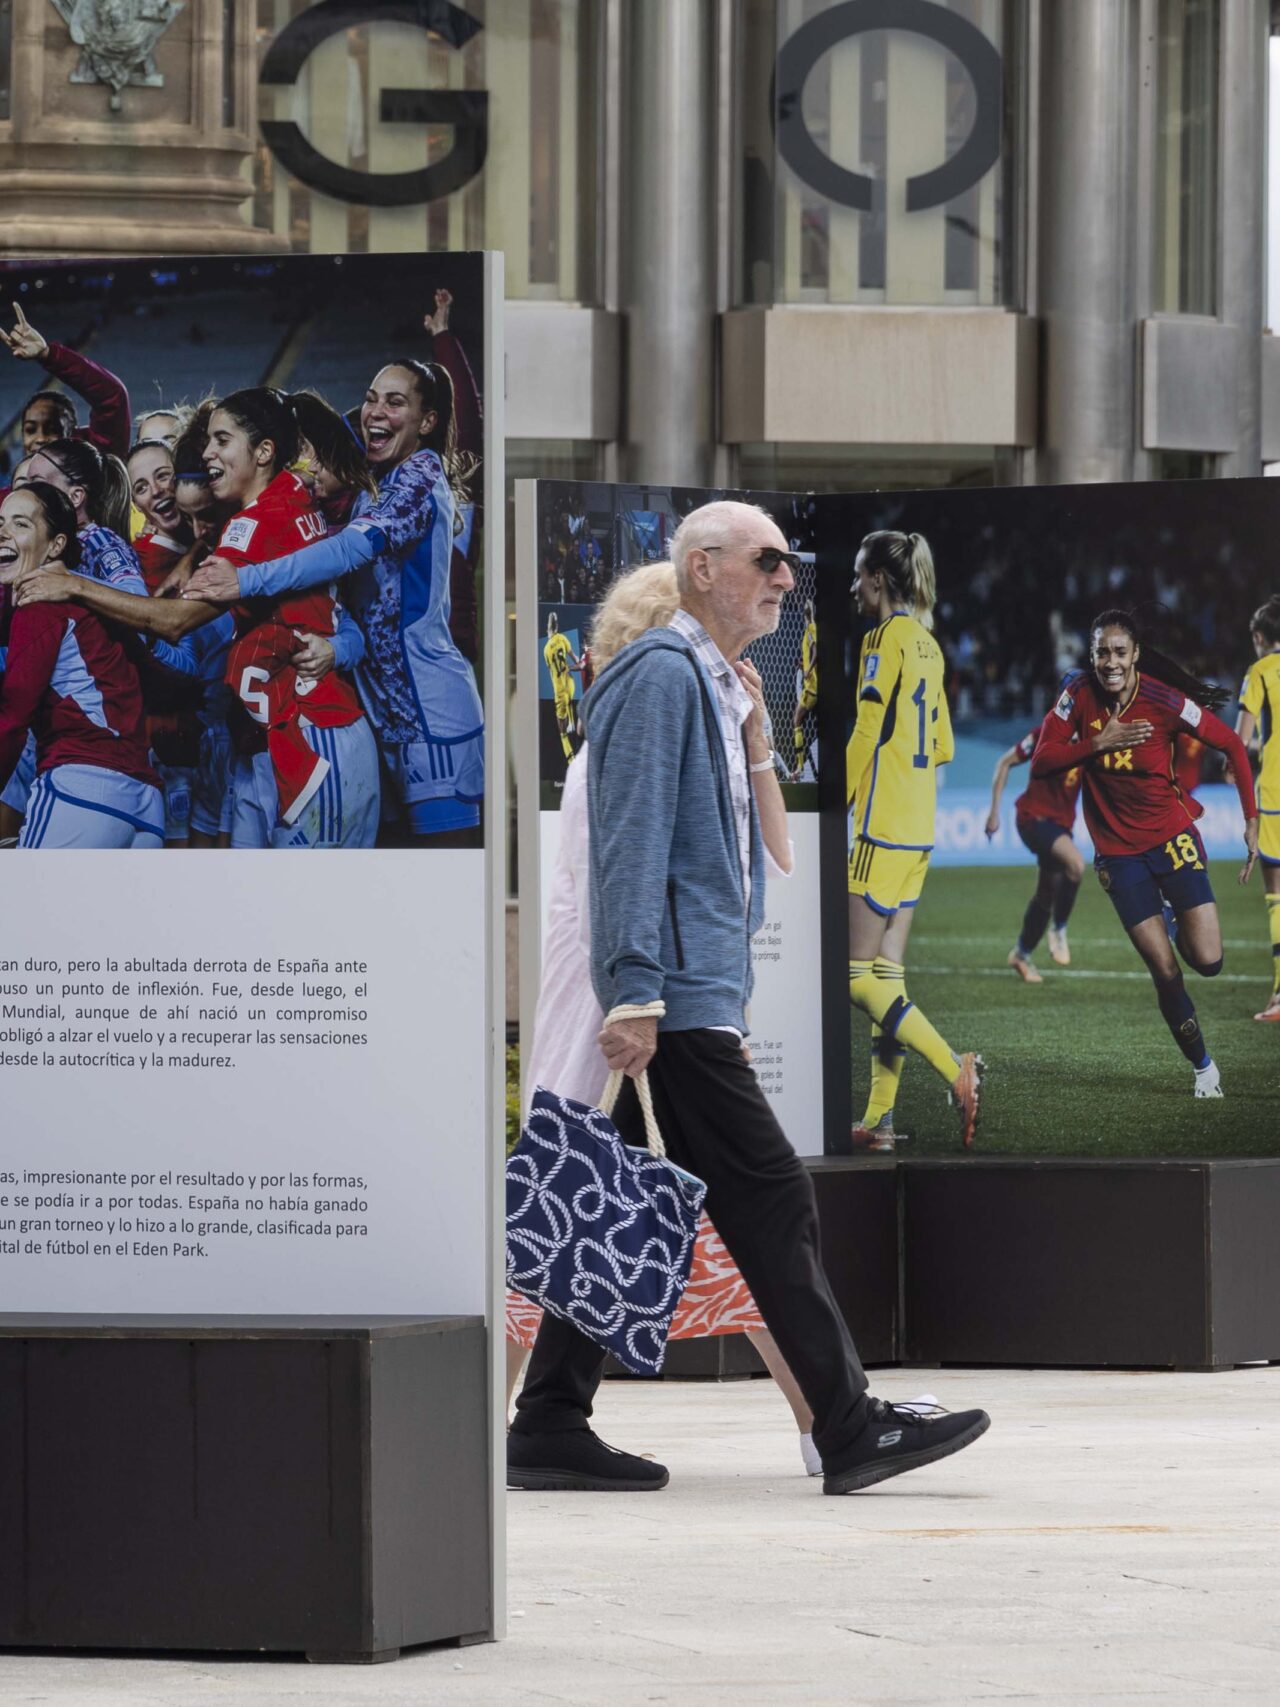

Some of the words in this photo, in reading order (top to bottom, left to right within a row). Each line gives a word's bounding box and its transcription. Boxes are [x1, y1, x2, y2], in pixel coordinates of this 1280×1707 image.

[1165, 832, 1199, 871] 18
[24, 956, 62, 975] duro,
[67, 960, 101, 975] pero
[106, 957, 119, 973] la
[124, 957, 188, 973] abultada
[193, 957, 248, 973] derrota
[253, 957, 272, 973] de
[277, 958, 329, 976] España
[334, 960, 368, 974] ante
[35, 984, 54, 996] un
[61, 982, 105, 999] punto
[111, 980, 130, 996] de
[137, 980, 204, 997] inflexión.
[212, 981, 243, 999] Fue,
[250, 981, 295, 997] desde
[302, 981, 347, 1001] luego,
[354, 981, 368, 998] el
[2, 1003, 66, 1022] Mundial,
[75, 1008, 130, 1023] aunque
[139, 1004, 158, 1020] de
[167, 1004, 190, 1020] ahí
[199, 1005, 238, 1021] nació
[247, 1009, 266, 1021] un
[275, 1006, 368, 1024] compromiso
[46, 1031, 55, 1043] a
[59, 1027, 94, 1043] alzar
[96, 1027, 110, 1043] el
[113, 1027, 154, 1044] vuelo
[156, 1032, 166, 1047] y
[168, 1032, 177, 1044] a
[181, 1032, 253, 1047] recuperar
[256, 1029, 276, 1045] las
[279, 1030, 368, 1045] sensaciones
[42, 1050, 55, 1067] la
[58, 1051, 135, 1067] autocrítica
[138, 1055, 148, 1071] y
[151, 1051, 164, 1067] la
[168, 1052, 236, 1068] madurez.
[23, 1169, 127, 1187] impresionante
[130, 1173, 156, 1189] por
[159, 1170, 172, 1186] el
[176, 1171, 245, 1187] resultado
[247, 1175, 257, 1190] y
[260, 1175, 286, 1190] por
[289, 1172, 309, 1188] las
[312, 1172, 368, 1191] formas,
[13, 1195, 30, 1207] se
[34, 1192, 75, 1211] podía
[79, 1193, 91, 1208] ir
[94, 1197, 103, 1208] a
[108, 1197, 134, 1212] por
[137, 1193, 183, 1210] todas.
[188, 1195, 240, 1213] España
[245, 1199, 264, 1211] no
[269, 1195, 309, 1212] había
[313, 1196, 368, 1215] ganado
[19, 1219, 52, 1234] gran
[54, 1217, 104, 1232] torneo
[106, 1220, 116, 1236] y
[119, 1217, 133, 1233] lo
[136, 1217, 166, 1233] hizo
[168, 1221, 177, 1233] a
[181, 1217, 195, 1234] lo
[197, 1218, 253, 1237] grande,
[256, 1219, 332, 1236] clasificada
[335, 1224, 368, 1239] para
[24, 1239, 42, 1255] de
[45, 1239, 89, 1255] fútbol
[93, 1244, 111, 1256] en
[115, 1240, 128, 1256] el
[132, 1240, 169, 1257] Eden
[173, 1242, 209, 1257] Park.
